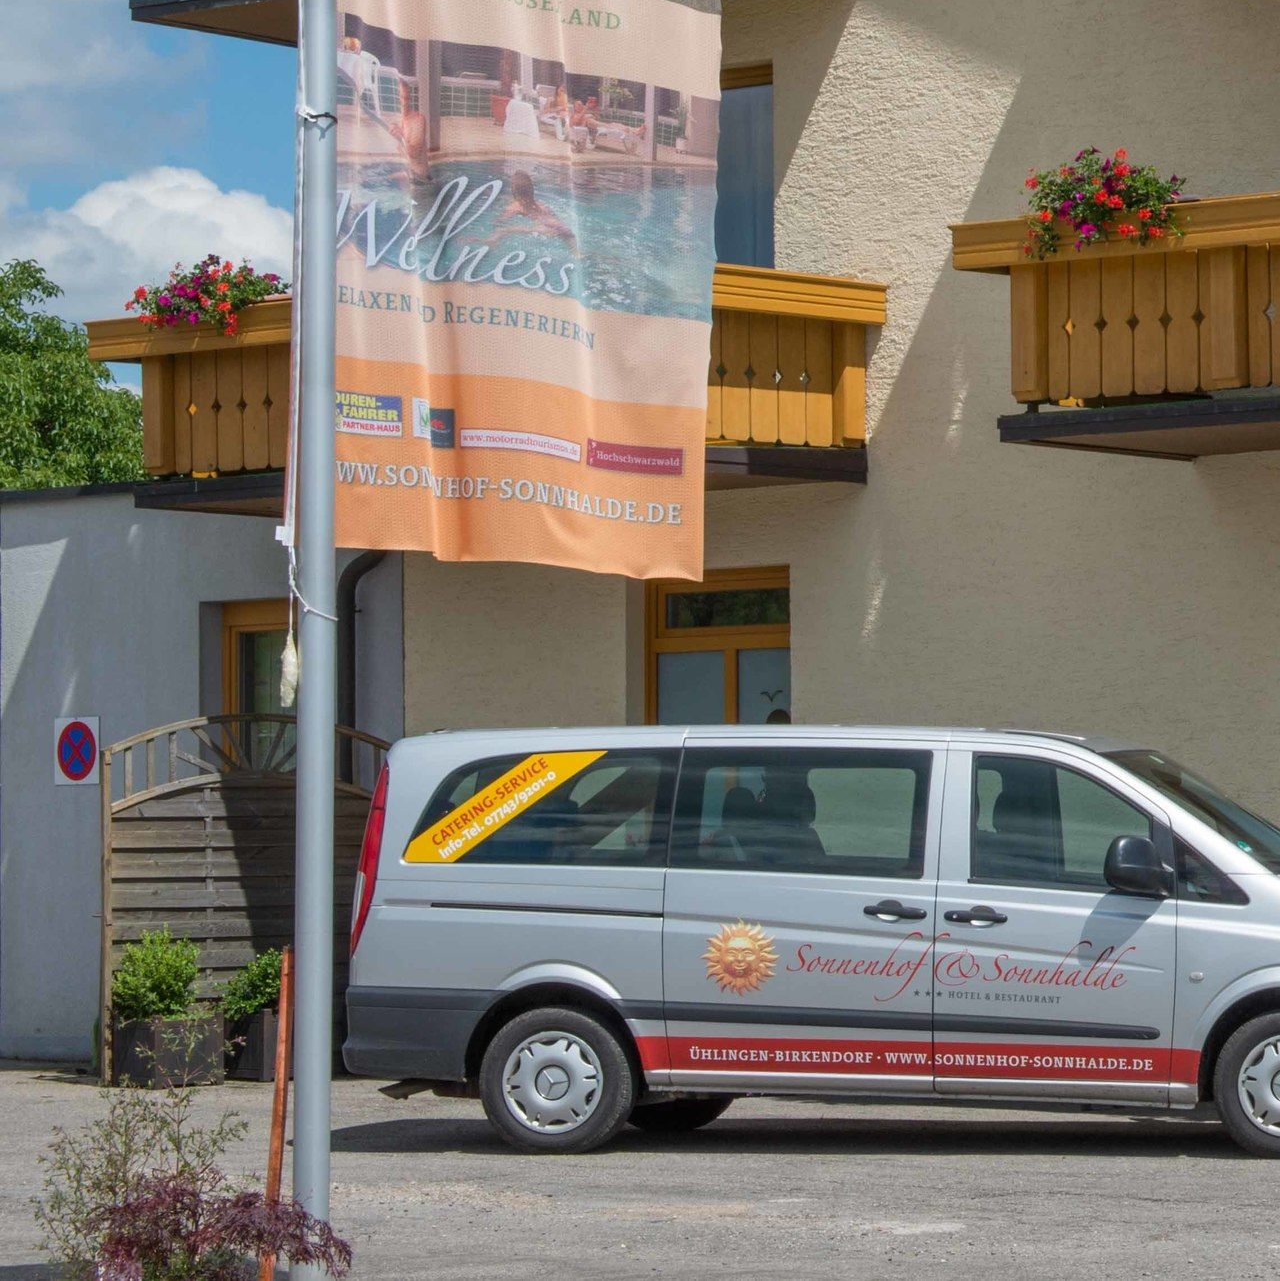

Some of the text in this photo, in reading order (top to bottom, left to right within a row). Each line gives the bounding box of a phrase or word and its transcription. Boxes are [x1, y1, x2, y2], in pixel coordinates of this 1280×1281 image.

[338, 284, 412, 313] ELAXEN
[443, 301, 595, 351] REGENERIERN
[336, 391, 382, 409] UREN-
[343, 405, 399, 421] FAHRER
[342, 420, 401, 433] PARTNER-HAUS
[596, 449, 680, 467] Hochschwarzwald
[432, 758, 549, 846] CATERING-SERVICE
[438, 770, 556, 859] Info-Tel. 07743/9201-0
[786, 931, 1136, 1003] Sonnenhof & Sonnhalde
[948, 990, 1062, 1005] HOTEL & RESTAURANT
[689, 1045, 874, 1064] ÜHLINGEN-BIRKENDORF
